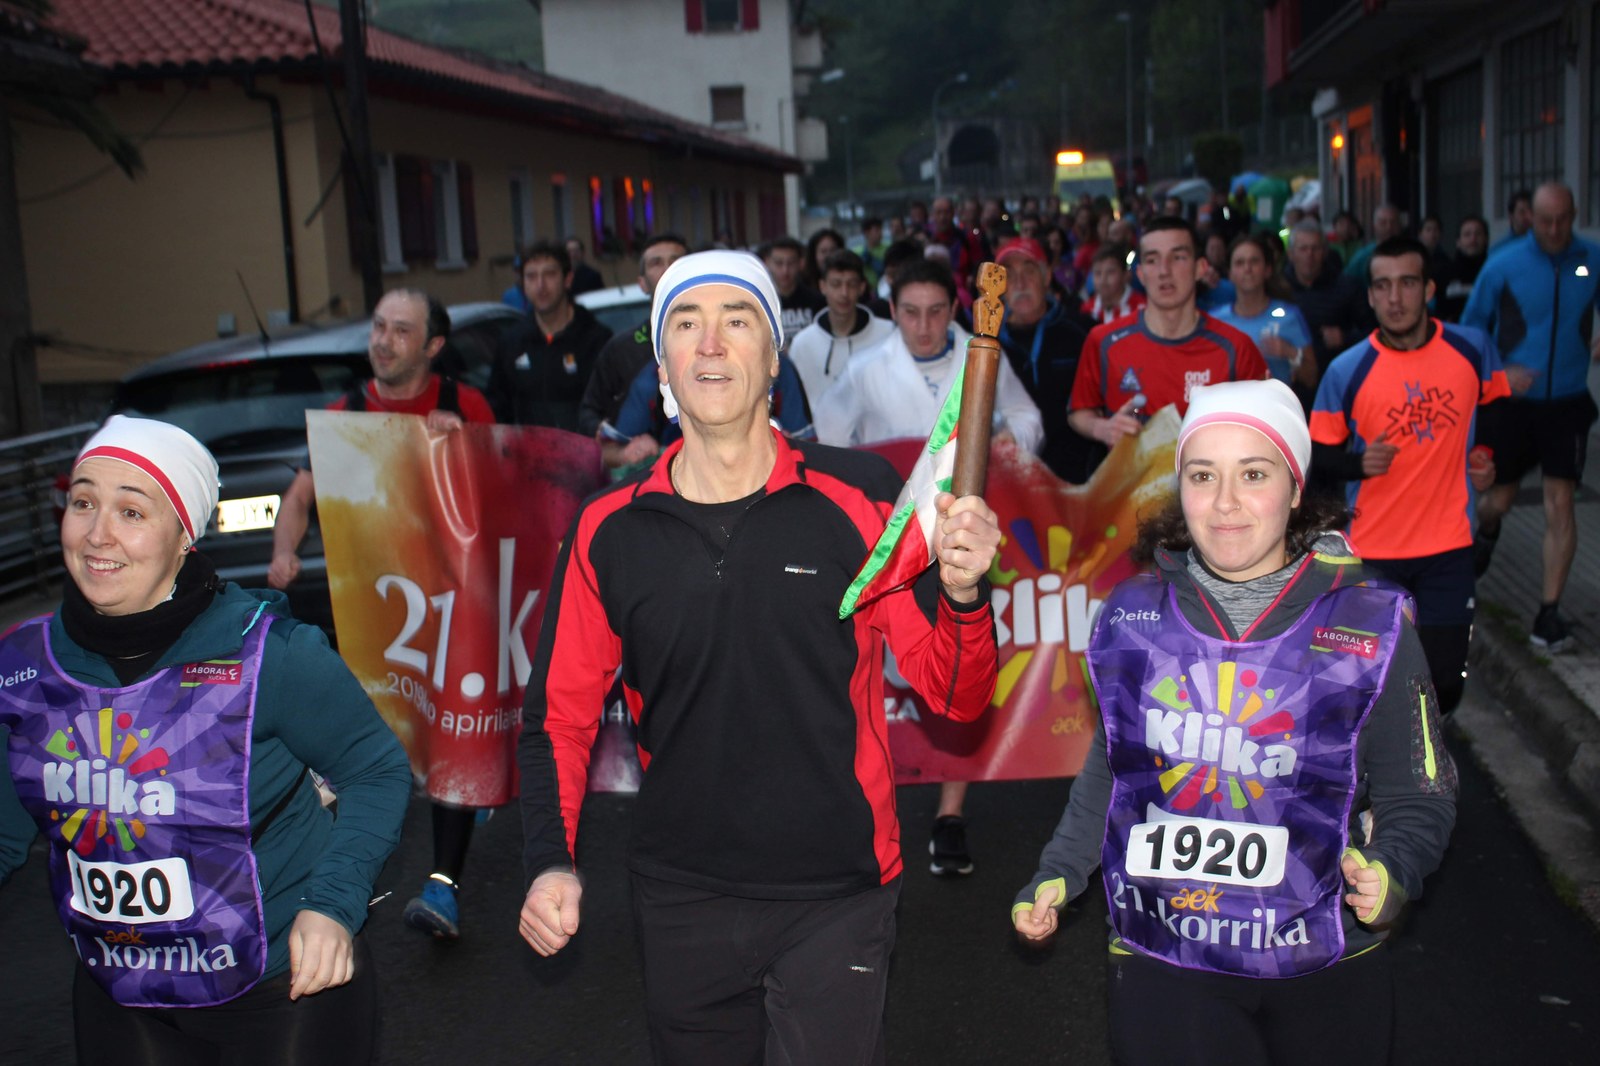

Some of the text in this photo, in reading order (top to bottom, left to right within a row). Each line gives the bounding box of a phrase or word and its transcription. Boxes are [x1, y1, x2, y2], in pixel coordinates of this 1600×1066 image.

[991, 573, 1103, 652] lik
[1125, 609, 1161, 622] eitb
[1316, 631, 1362, 645] LABORAL
[4, 667, 38, 687] eitb
[186, 667, 227, 675] LABORAL
[1051, 714, 1084, 734] aek
[1145, 708, 1297, 778] Klika
[42, 758, 176, 816] Klika
[1145, 825, 1268, 879] 1920
[76, 863, 172, 916] 1920
[1170, 883, 1224, 913] aek
[103, 926, 146, 945] aek
